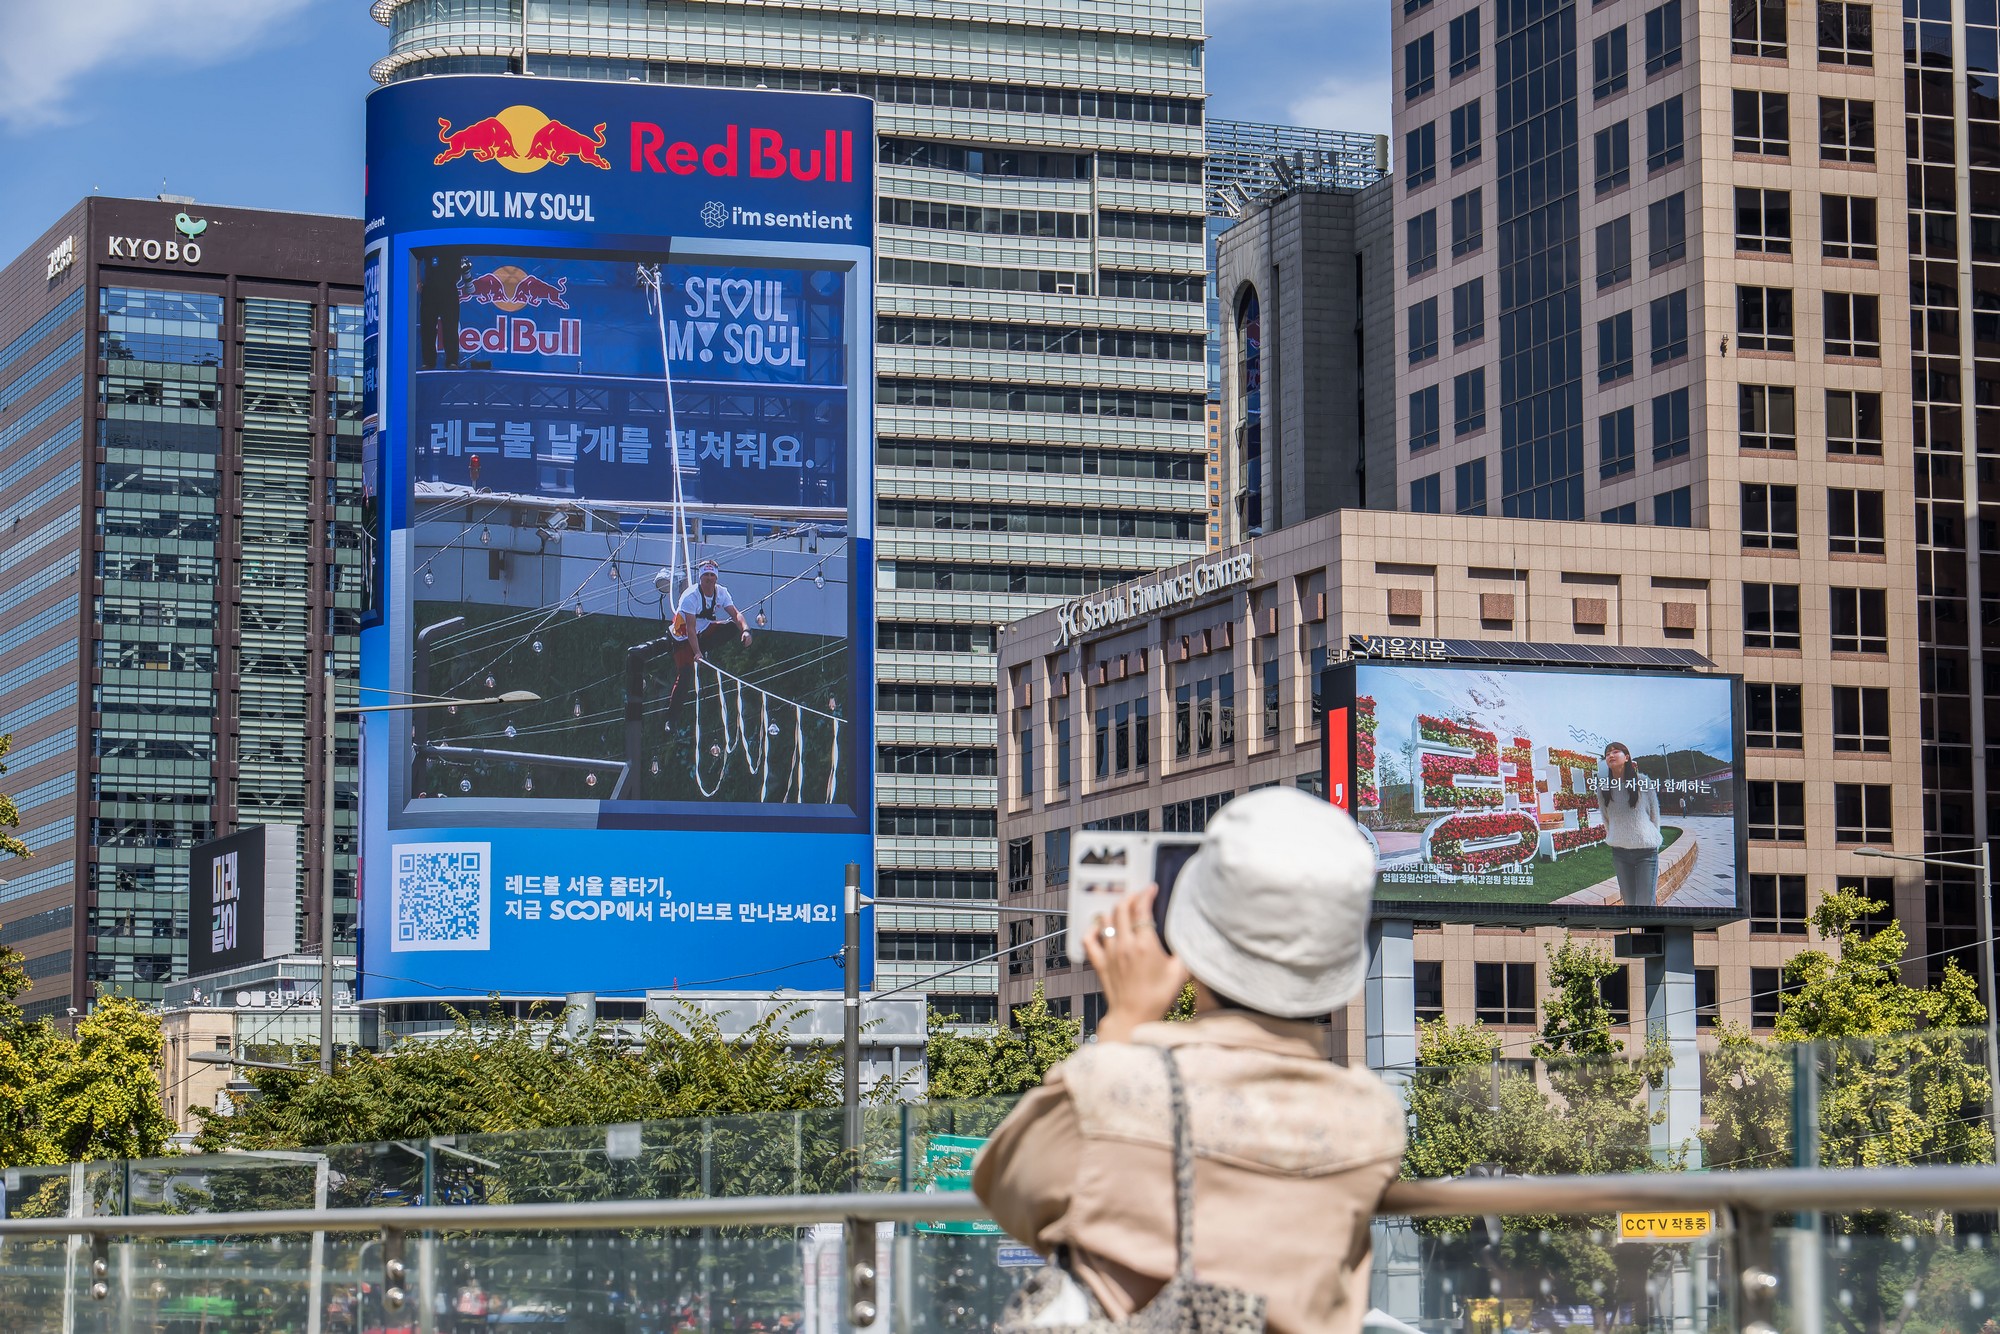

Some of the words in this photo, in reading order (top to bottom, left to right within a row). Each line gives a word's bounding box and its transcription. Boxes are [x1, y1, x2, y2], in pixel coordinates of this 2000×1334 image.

[630, 121, 738, 177] Red
[750, 127, 853, 183] Bull
[540, 193, 595, 222] SOUL
[764, 210, 853, 230] sentient
[108, 236, 201, 263] KYOBO
[435, 315, 508, 353] ed
[511, 317, 582, 357] Bull
[723, 322, 806, 366] SOUL
[430, 419, 535, 459] 레드불
[548, 423, 652, 464] 날개를
[665, 429, 815, 470] 펼쳐줘요.
[1082, 596, 1129, 632] SEOUL
[1129, 571, 1194, 617] FINANCE
[1194, 553, 1252, 596] CENTER
[1367, 638, 1446, 660] 서울신문
[1625, 777, 1661, 792] 자연과
[1664, 778, 1711, 794] 함께하는
[1386, 862, 1418, 873] 2026년
[505, 875, 561, 896] 레드불
[566, 875, 604, 897] 서울
[610, 876, 672, 900] 줄타기,
[505, 900, 542, 920] 지금
[659, 901, 733, 922] 라이브로
[738, 902, 837, 924] 만나보세요!
[1625, 1218, 1668, 1231] CCTV
[1671, 1217, 1707, 1231] 작동중
